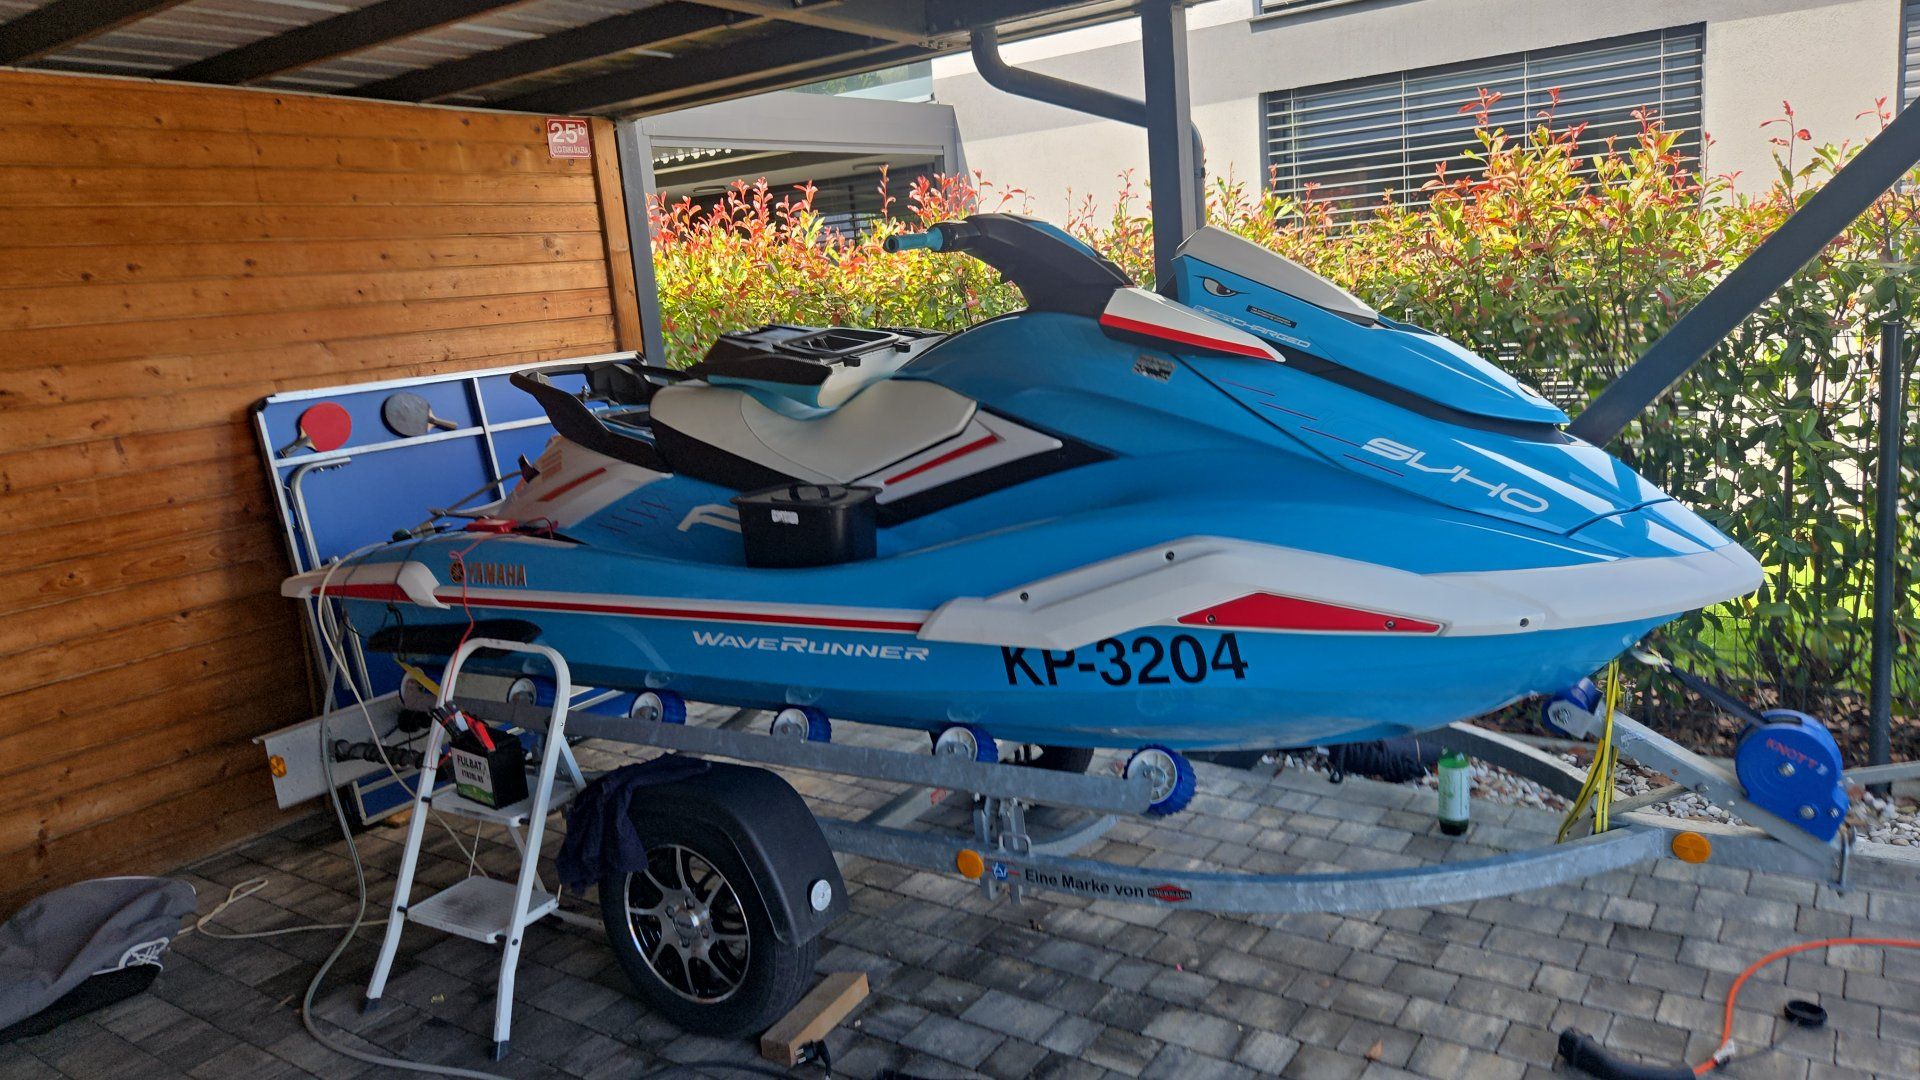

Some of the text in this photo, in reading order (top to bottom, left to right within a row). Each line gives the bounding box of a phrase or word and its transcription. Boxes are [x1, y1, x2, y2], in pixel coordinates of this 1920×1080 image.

[1361, 437, 1549, 513] SVHO
[468, 562, 527, 588] YAMAHA
[1001, 633, 1249, 686] KP-3204
[457, 754, 483, 771] FULBAT
[1766, 738, 1819, 769] KNOTT
[1025, 869, 1057, 885] Eine
[1061, 875, 1109, 894] Marke
[1114, 883, 1144, 898] von
